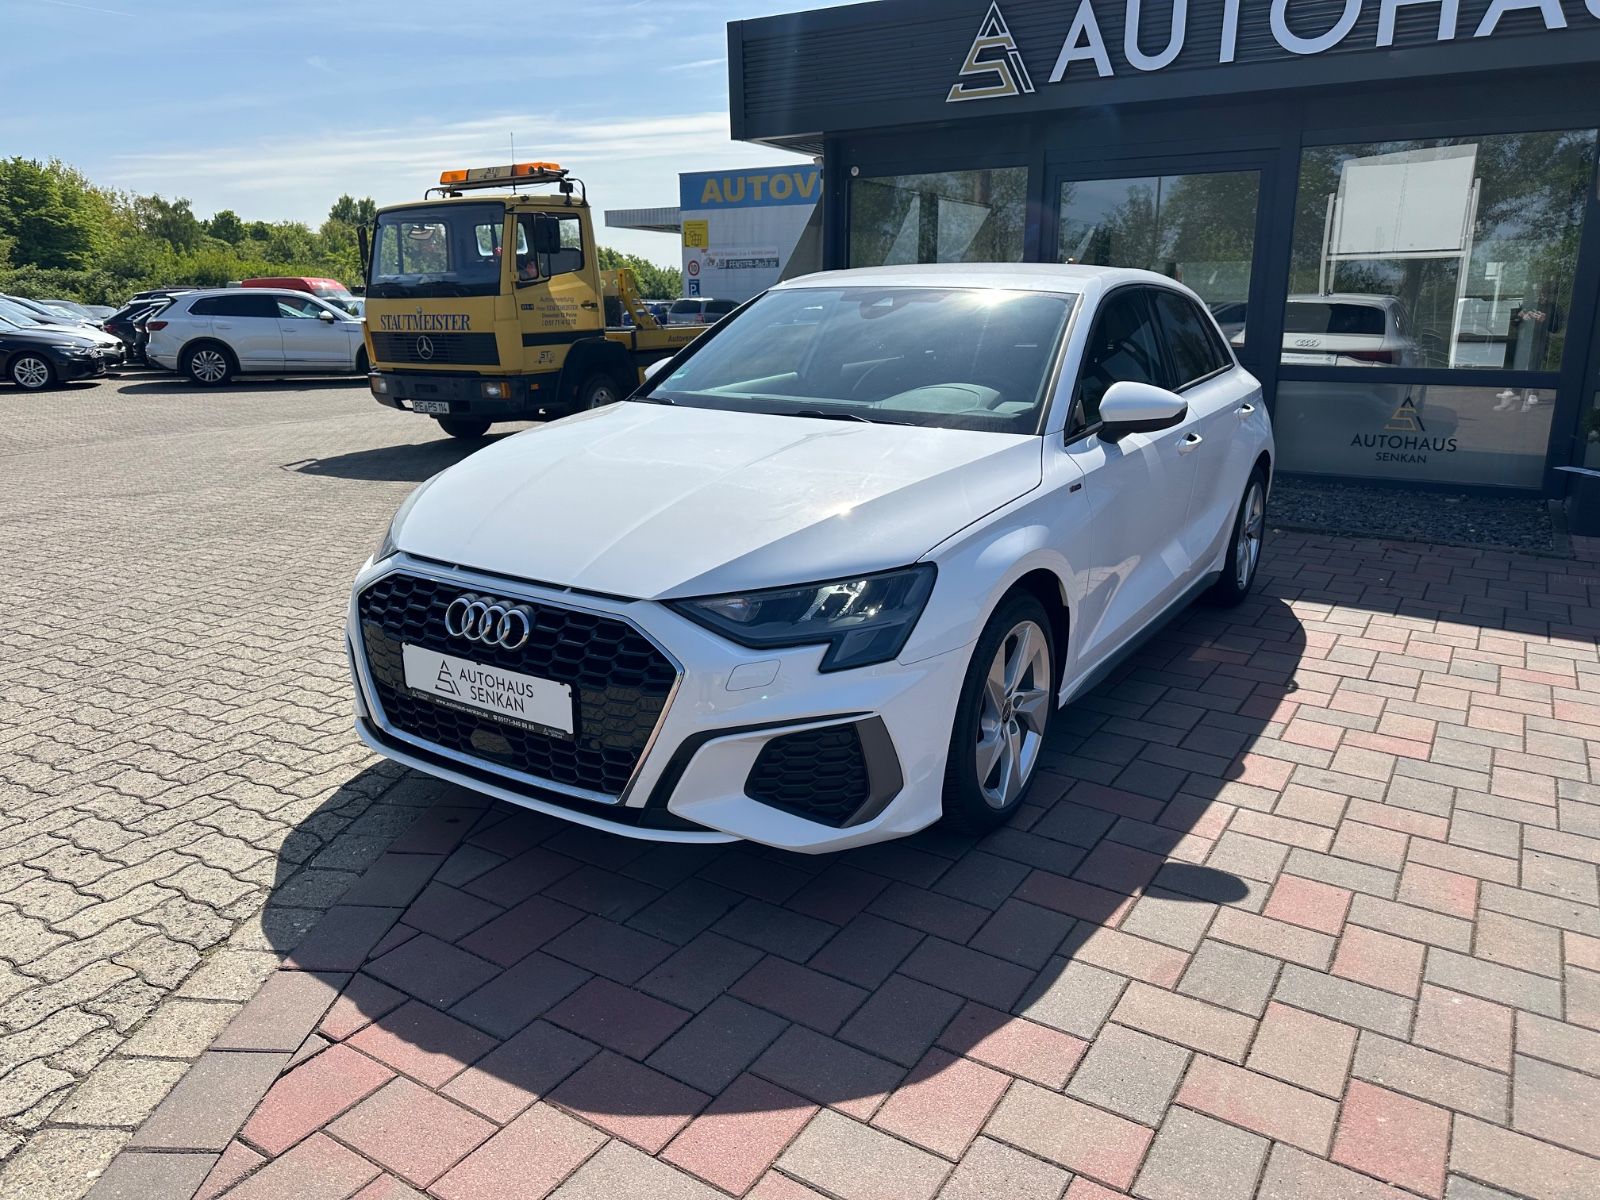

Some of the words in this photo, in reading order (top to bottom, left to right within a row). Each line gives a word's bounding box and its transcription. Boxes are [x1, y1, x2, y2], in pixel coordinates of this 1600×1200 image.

[701, 172, 819, 204] AUTOV
[690, 284, 698, 295] P
[380, 314, 471, 331] STAUTMEISTER
[1350, 433, 1458, 452] AUTOHAUS
[1376, 451, 1427, 464] SENKAN
[459, 668, 534, 698] AUTOHAUS
[470, 685, 525, 714] SENKAN
